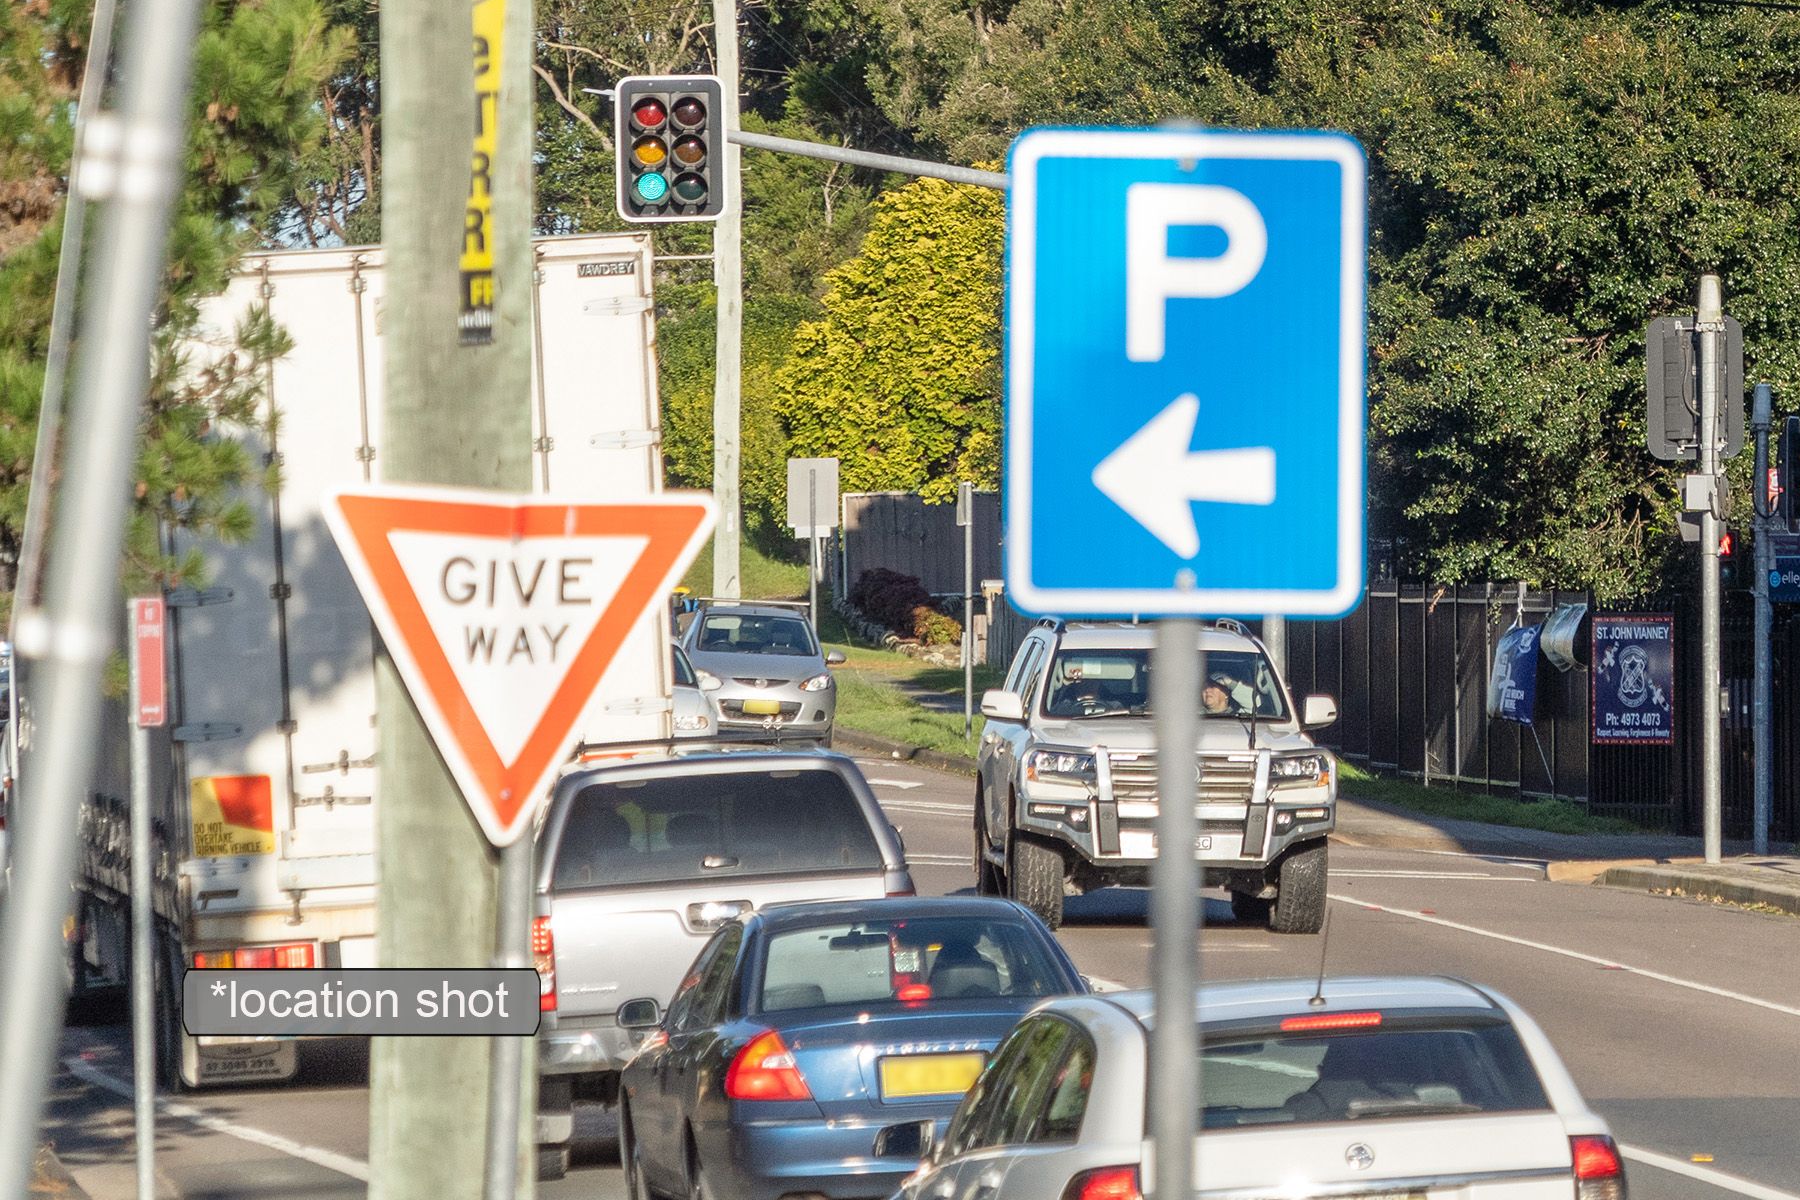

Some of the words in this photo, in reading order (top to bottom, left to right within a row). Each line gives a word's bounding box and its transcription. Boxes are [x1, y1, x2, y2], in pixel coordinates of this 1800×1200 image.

[578, 262, 634, 276] VAWDREY
[1126, 183, 1268, 363] P
[440, 556, 593, 608] GIVE
[1596, 626, 1609, 640] ST.
[1610, 626, 1633, 640] JOHN
[1633, 626, 1670, 640] VIANNEY
[464, 624, 569, 665] WAY
[1605, 712, 1619, 726] Ph:
[1620, 712, 1641, 726] 4973
[1641, 712, 1661, 726] 4073
[194, 822, 205, 834] DO
[207, 822, 223, 833] NOT
[194, 832, 233, 845] OVERTAKE
